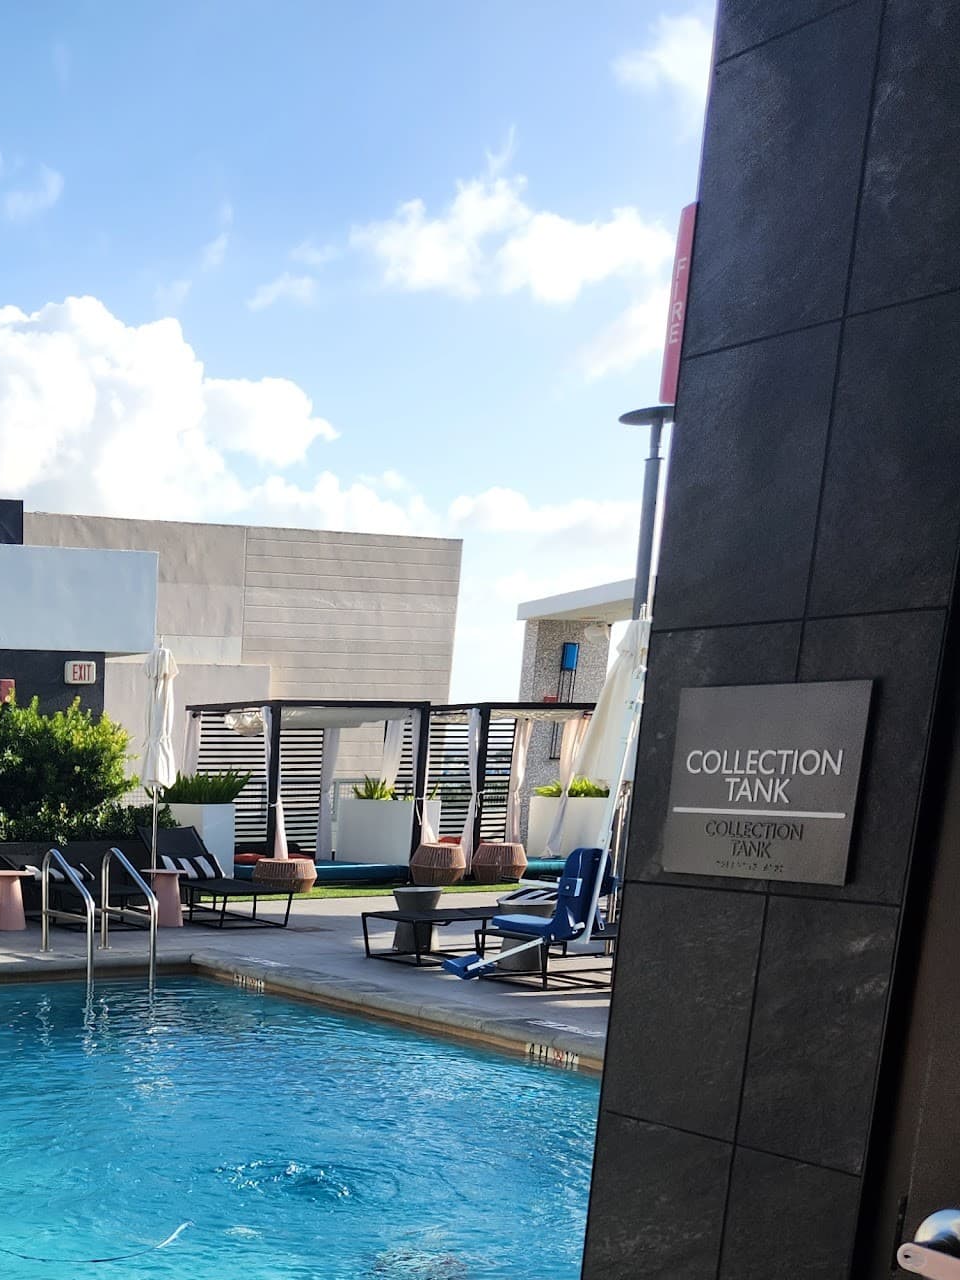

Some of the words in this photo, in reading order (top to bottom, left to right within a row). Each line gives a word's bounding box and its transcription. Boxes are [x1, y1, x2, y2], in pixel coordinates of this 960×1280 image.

[669, 256, 687, 345] FIRE
[72, 664, 92, 681] EXIT
[686, 749, 844, 776] COLLECTION
[724, 777, 791, 804] TANK
[705, 820, 804, 841] COLLECTION
[730, 839, 773, 859] TANK
